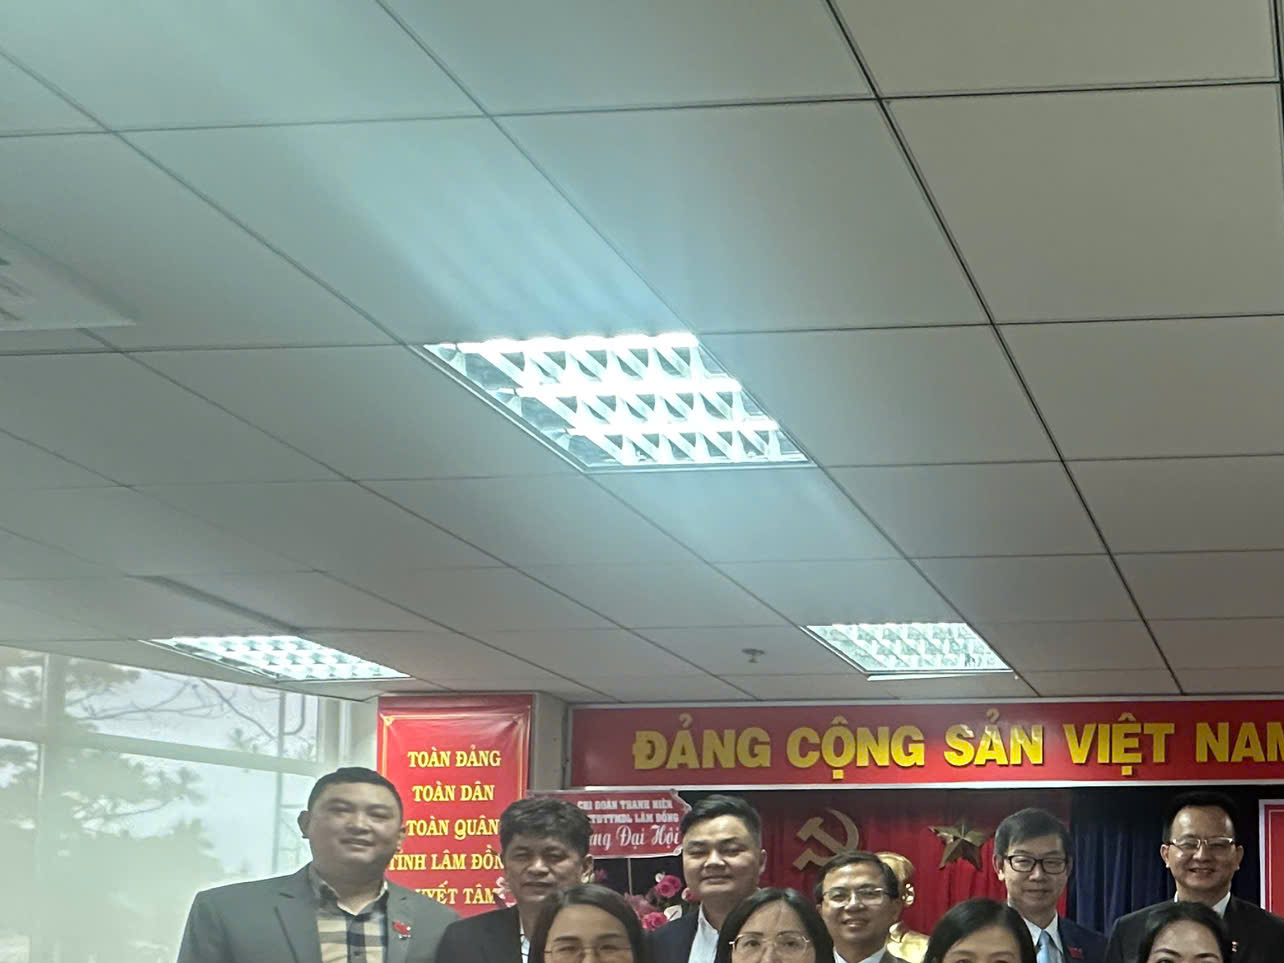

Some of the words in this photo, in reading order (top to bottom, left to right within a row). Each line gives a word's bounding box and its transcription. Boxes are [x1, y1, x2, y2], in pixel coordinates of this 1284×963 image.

[407, 746, 451, 768] TOÀN
[455, 744, 501, 767] ĐẢNG
[632, 713, 771, 769] ĐẢNG
[786, 715, 925, 779] CỘNG
[943, 709, 1044, 766] SẢN
[1063, 711, 1175, 776] VIỆT
[412, 780, 456, 802] TOÀN
[460, 780, 495, 801] DÂN
[406, 815, 450, 836] TOÀN
[454, 814, 500, 841] QUÂN
[616, 825, 645, 849] Đại
[651, 824, 680, 848] Hội
[431, 849, 467, 870] LÂM
[471, 844, 504, 870] ĐỒN
